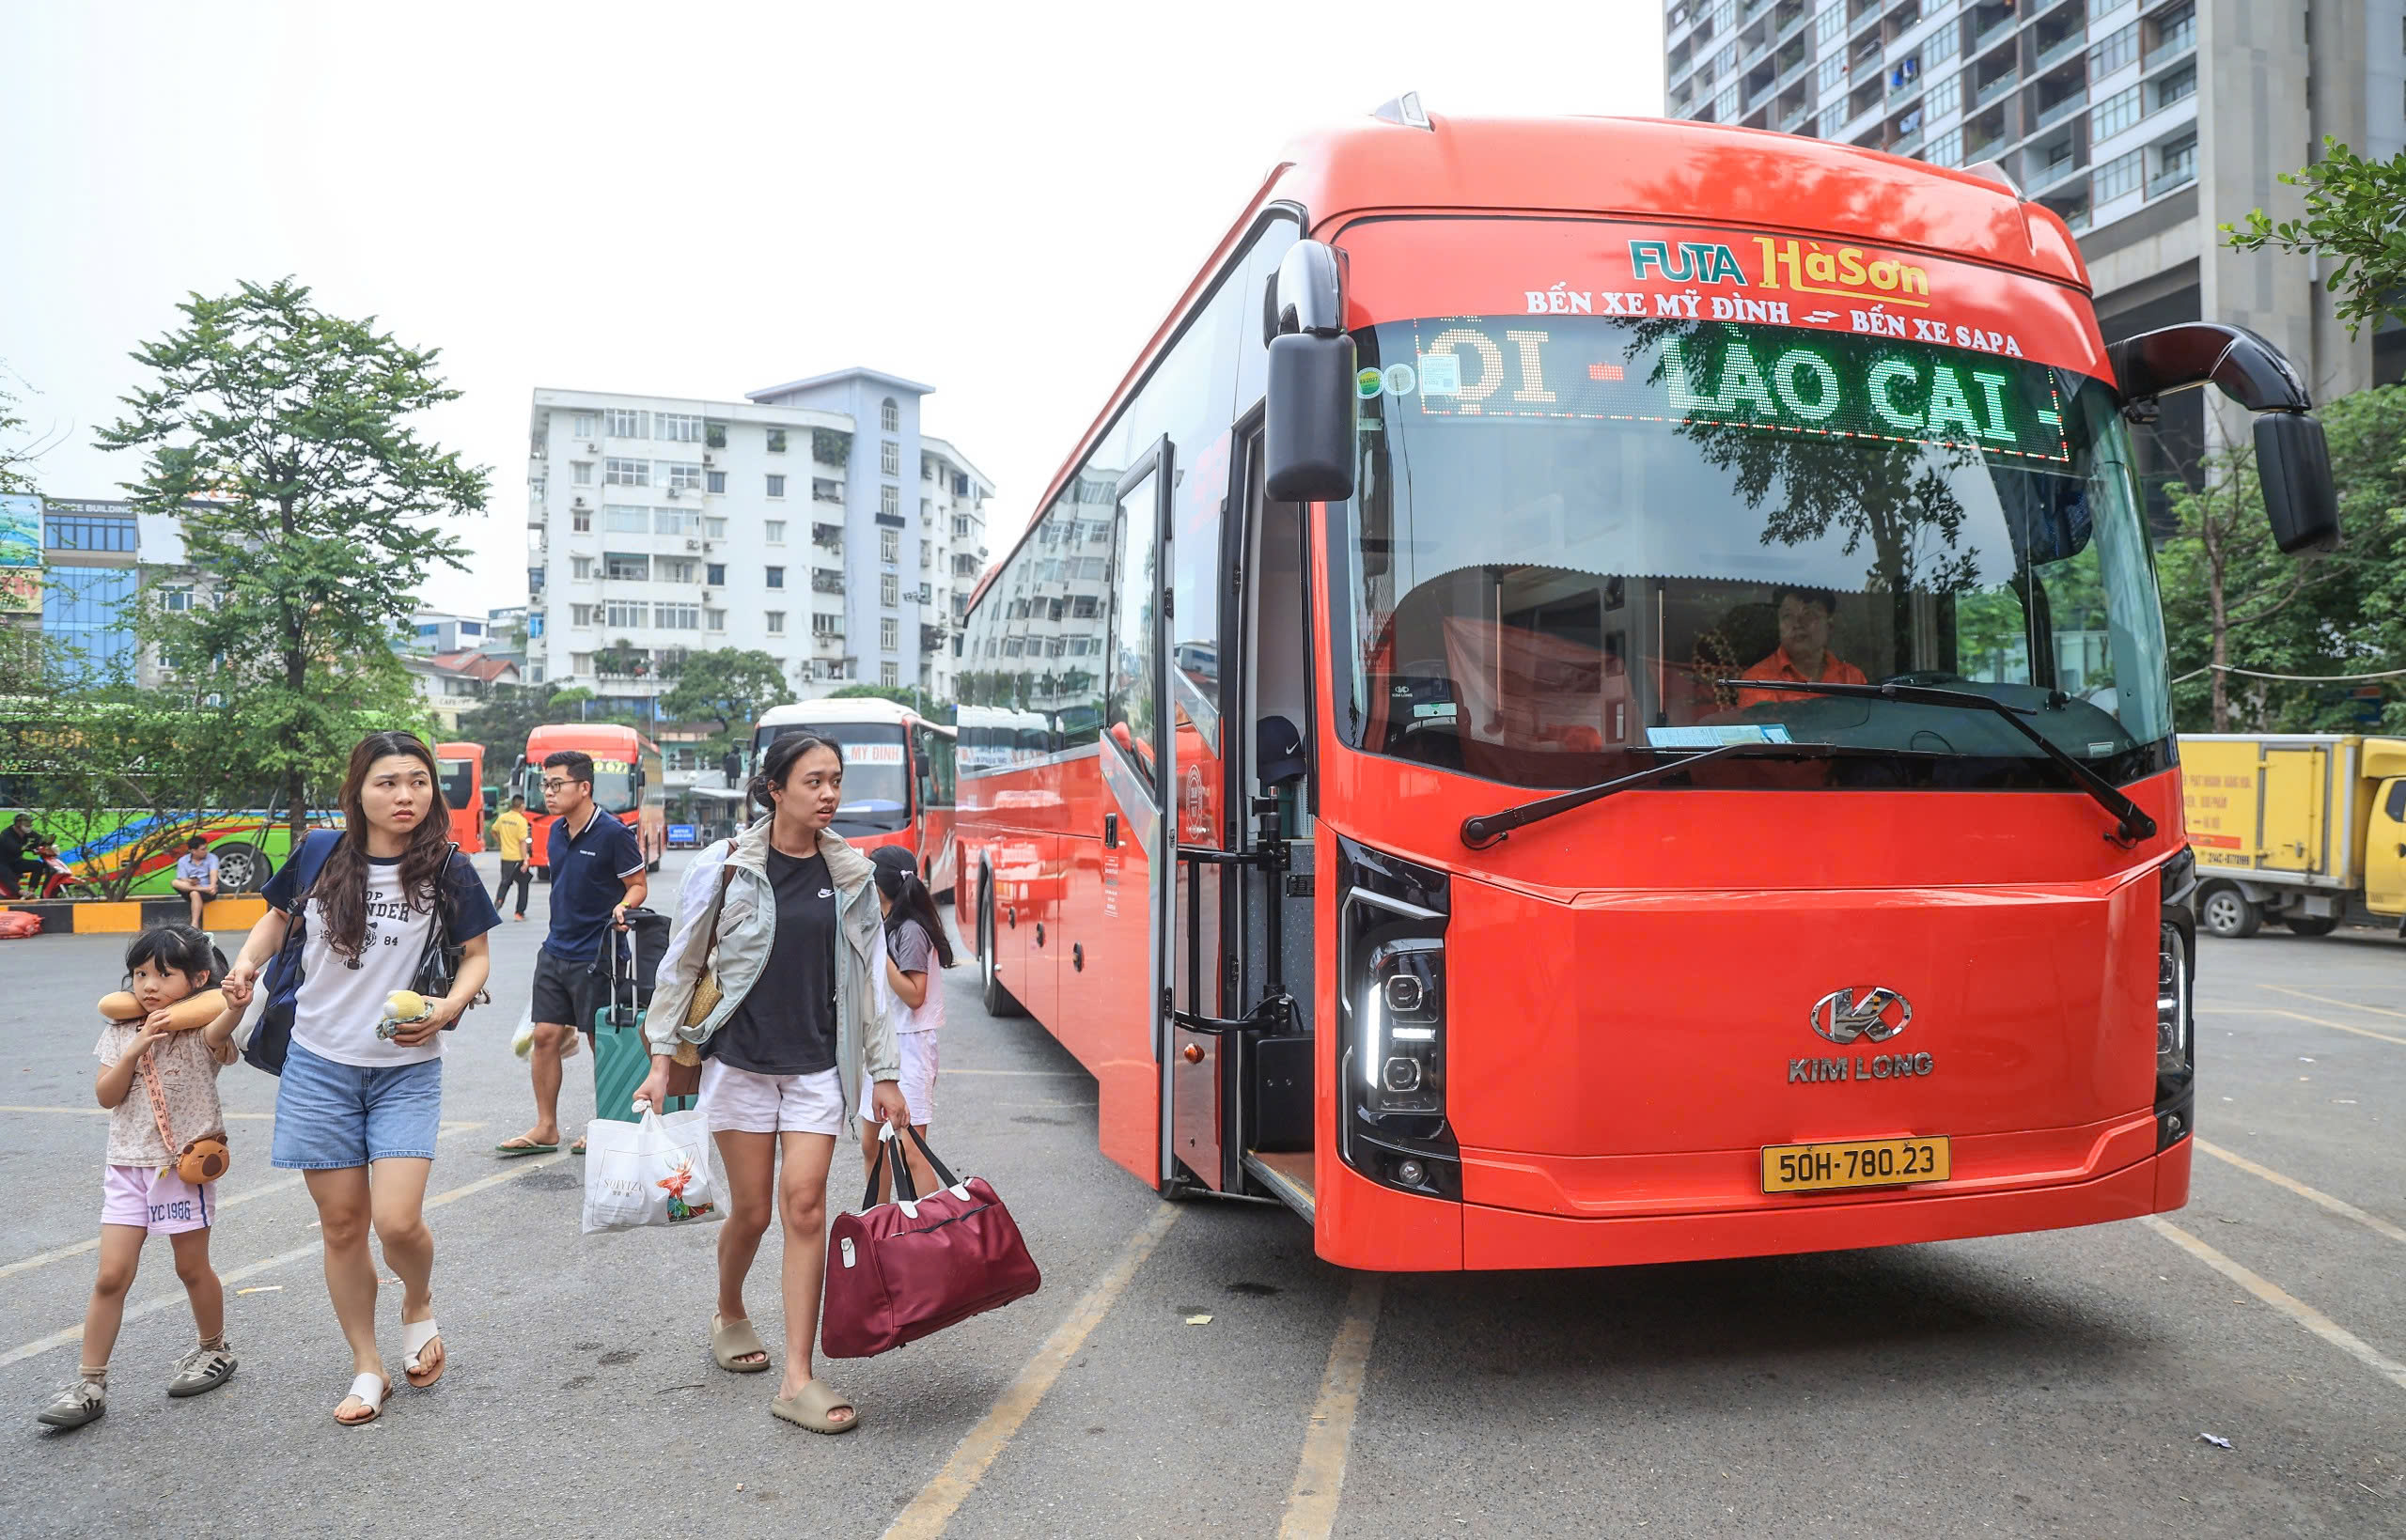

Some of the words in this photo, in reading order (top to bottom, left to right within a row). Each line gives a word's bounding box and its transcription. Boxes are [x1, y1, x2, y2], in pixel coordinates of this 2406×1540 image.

[1628, 240, 1748, 286] FUTA
[1524, 282, 1592, 315] BẾN
[1601, 292, 1647, 315] XE
[1654, 289, 1702, 318] MỸ
[1711, 292, 1791, 324] ĐÌNH
[1849, 304, 1906, 337] BẾN
[1913, 319, 1950, 344] XE
[1956, 325, 2023, 357] SAPA
[1662, 322, 1840, 420] LÀO
[1867, 359, 2017, 443] CAI
[86, 504, 133, 513] BUILDING
[366, 891, 383, 901] OP
[383, 936, 398, 946] 84
[1789, 1058, 1849, 1082] KIM
[1855, 1051, 1933, 1080] LONG
[1780, 1145, 1934, 1183] 50H-780.23
[148, 1205, 164, 1222] YC
